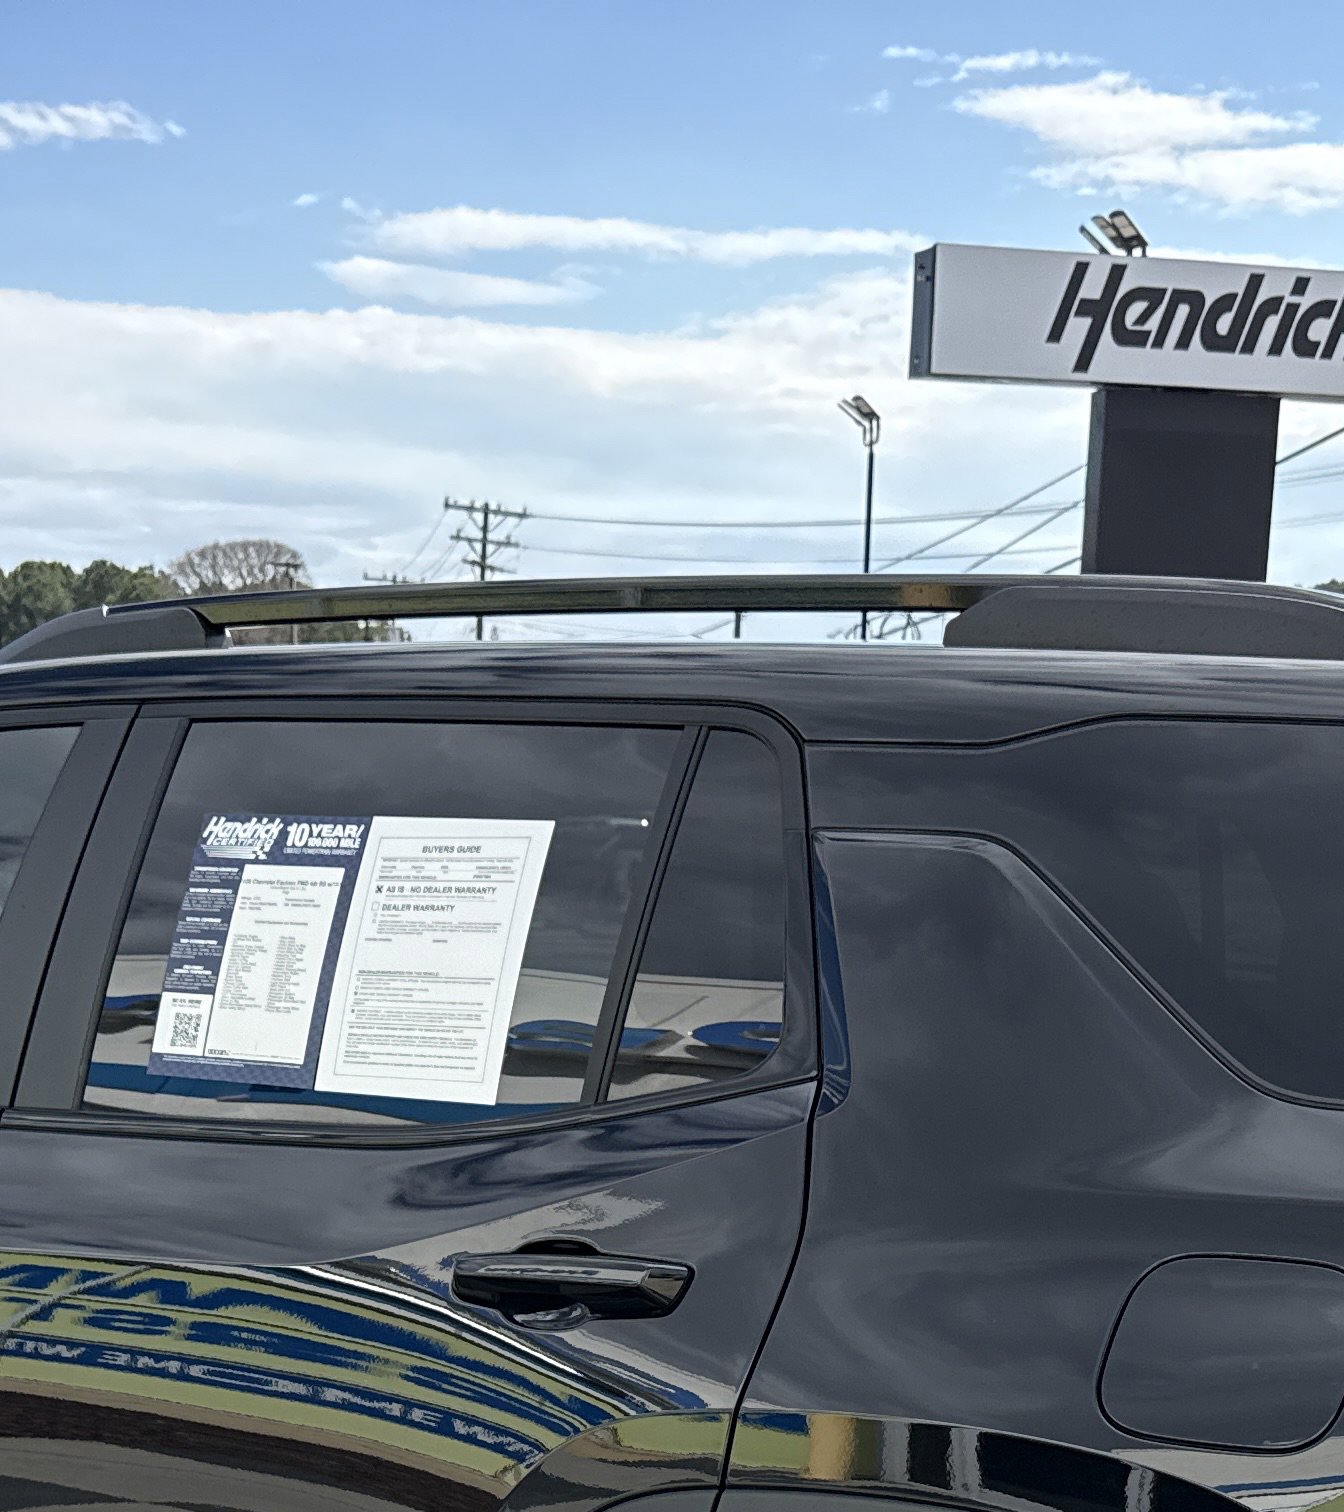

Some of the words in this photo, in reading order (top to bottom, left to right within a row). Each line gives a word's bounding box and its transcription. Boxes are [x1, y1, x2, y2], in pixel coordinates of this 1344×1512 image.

[202, 816, 284, 846] Hendrick
[286, 823, 310, 847] 10
[212, 838, 274, 847] CERTIFIED
[421, 845, 455, 854] BUYERS
[457, 845, 482, 854] GUIDE
[423, 886, 453, 894] DEALER
[454, 887, 497, 895] WARRANTY
[382, 903, 411, 911] DEALER
[413, 904, 455, 912] WARRANTY
